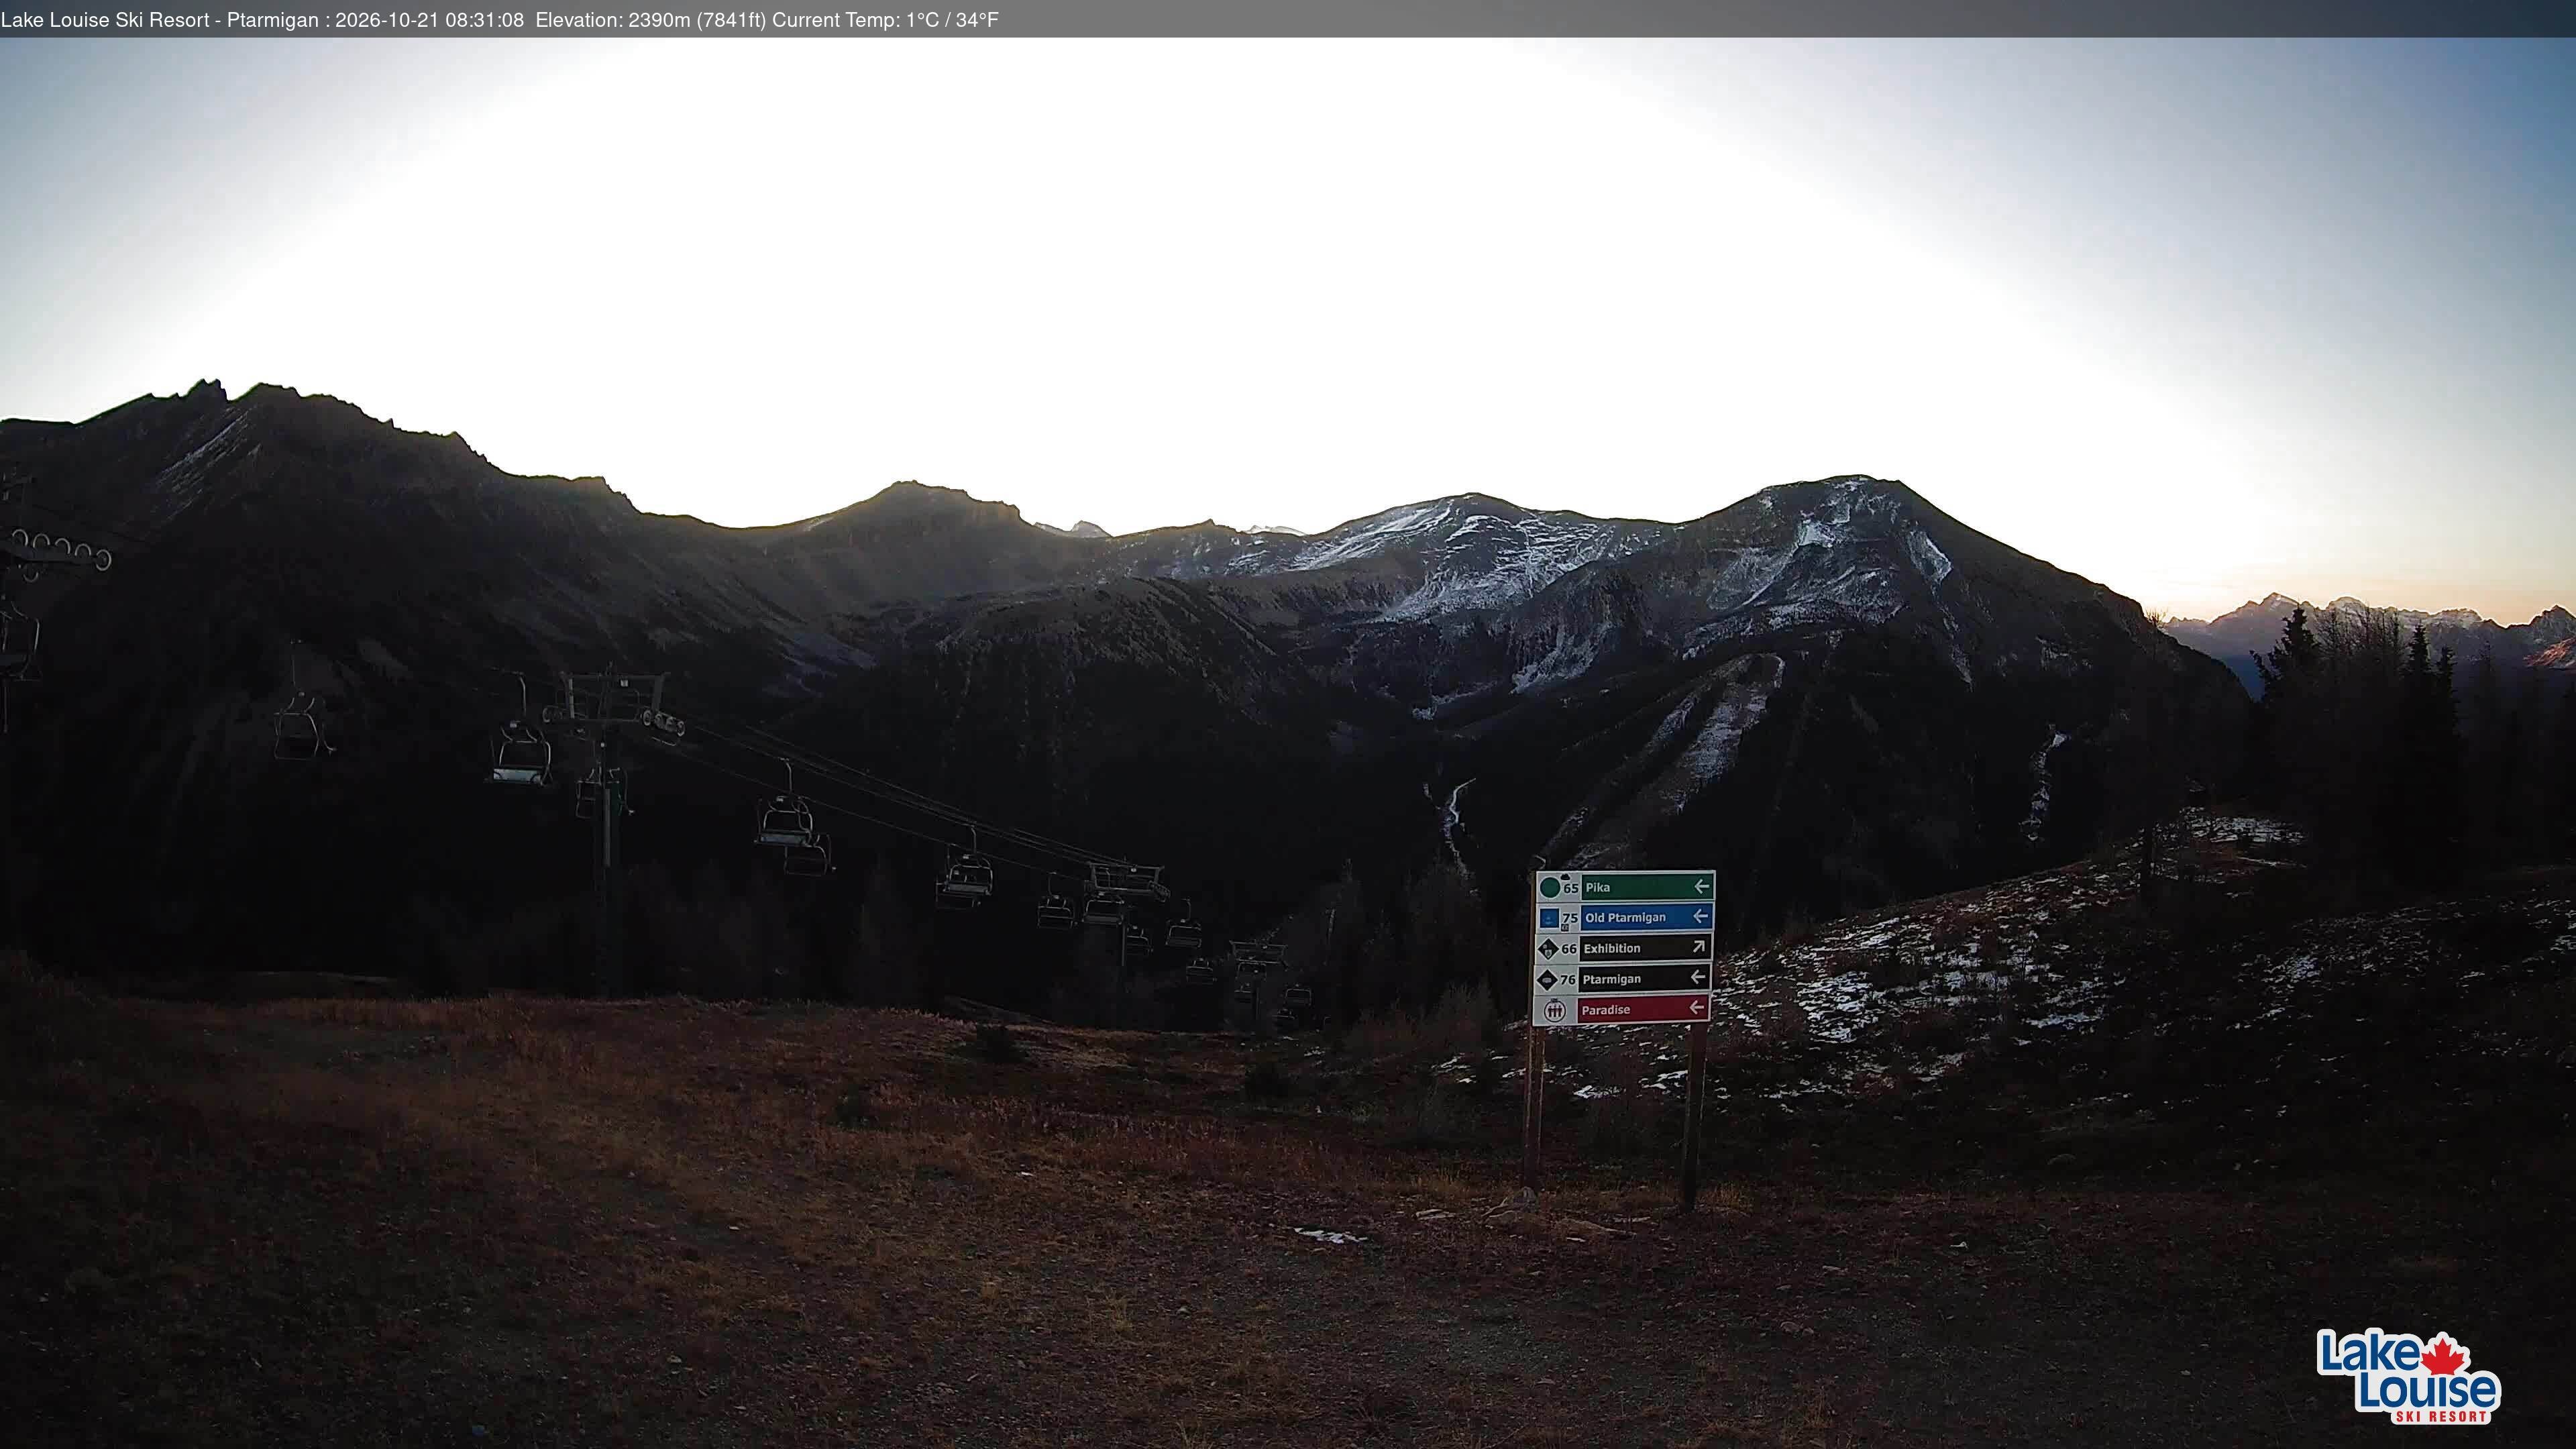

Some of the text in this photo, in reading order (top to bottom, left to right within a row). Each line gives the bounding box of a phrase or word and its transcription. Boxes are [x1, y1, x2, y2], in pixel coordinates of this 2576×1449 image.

[1564, 882, 1611, 894] 65 Pika
[1562, 912, 1666, 925] 75 Old Ptarmigan
[1561, 943, 1641, 954] 66 Exhibition
[1560, 973, 1642, 986] 76 Ptarmigan
[1582, 1005, 1631, 1015] Paradise
